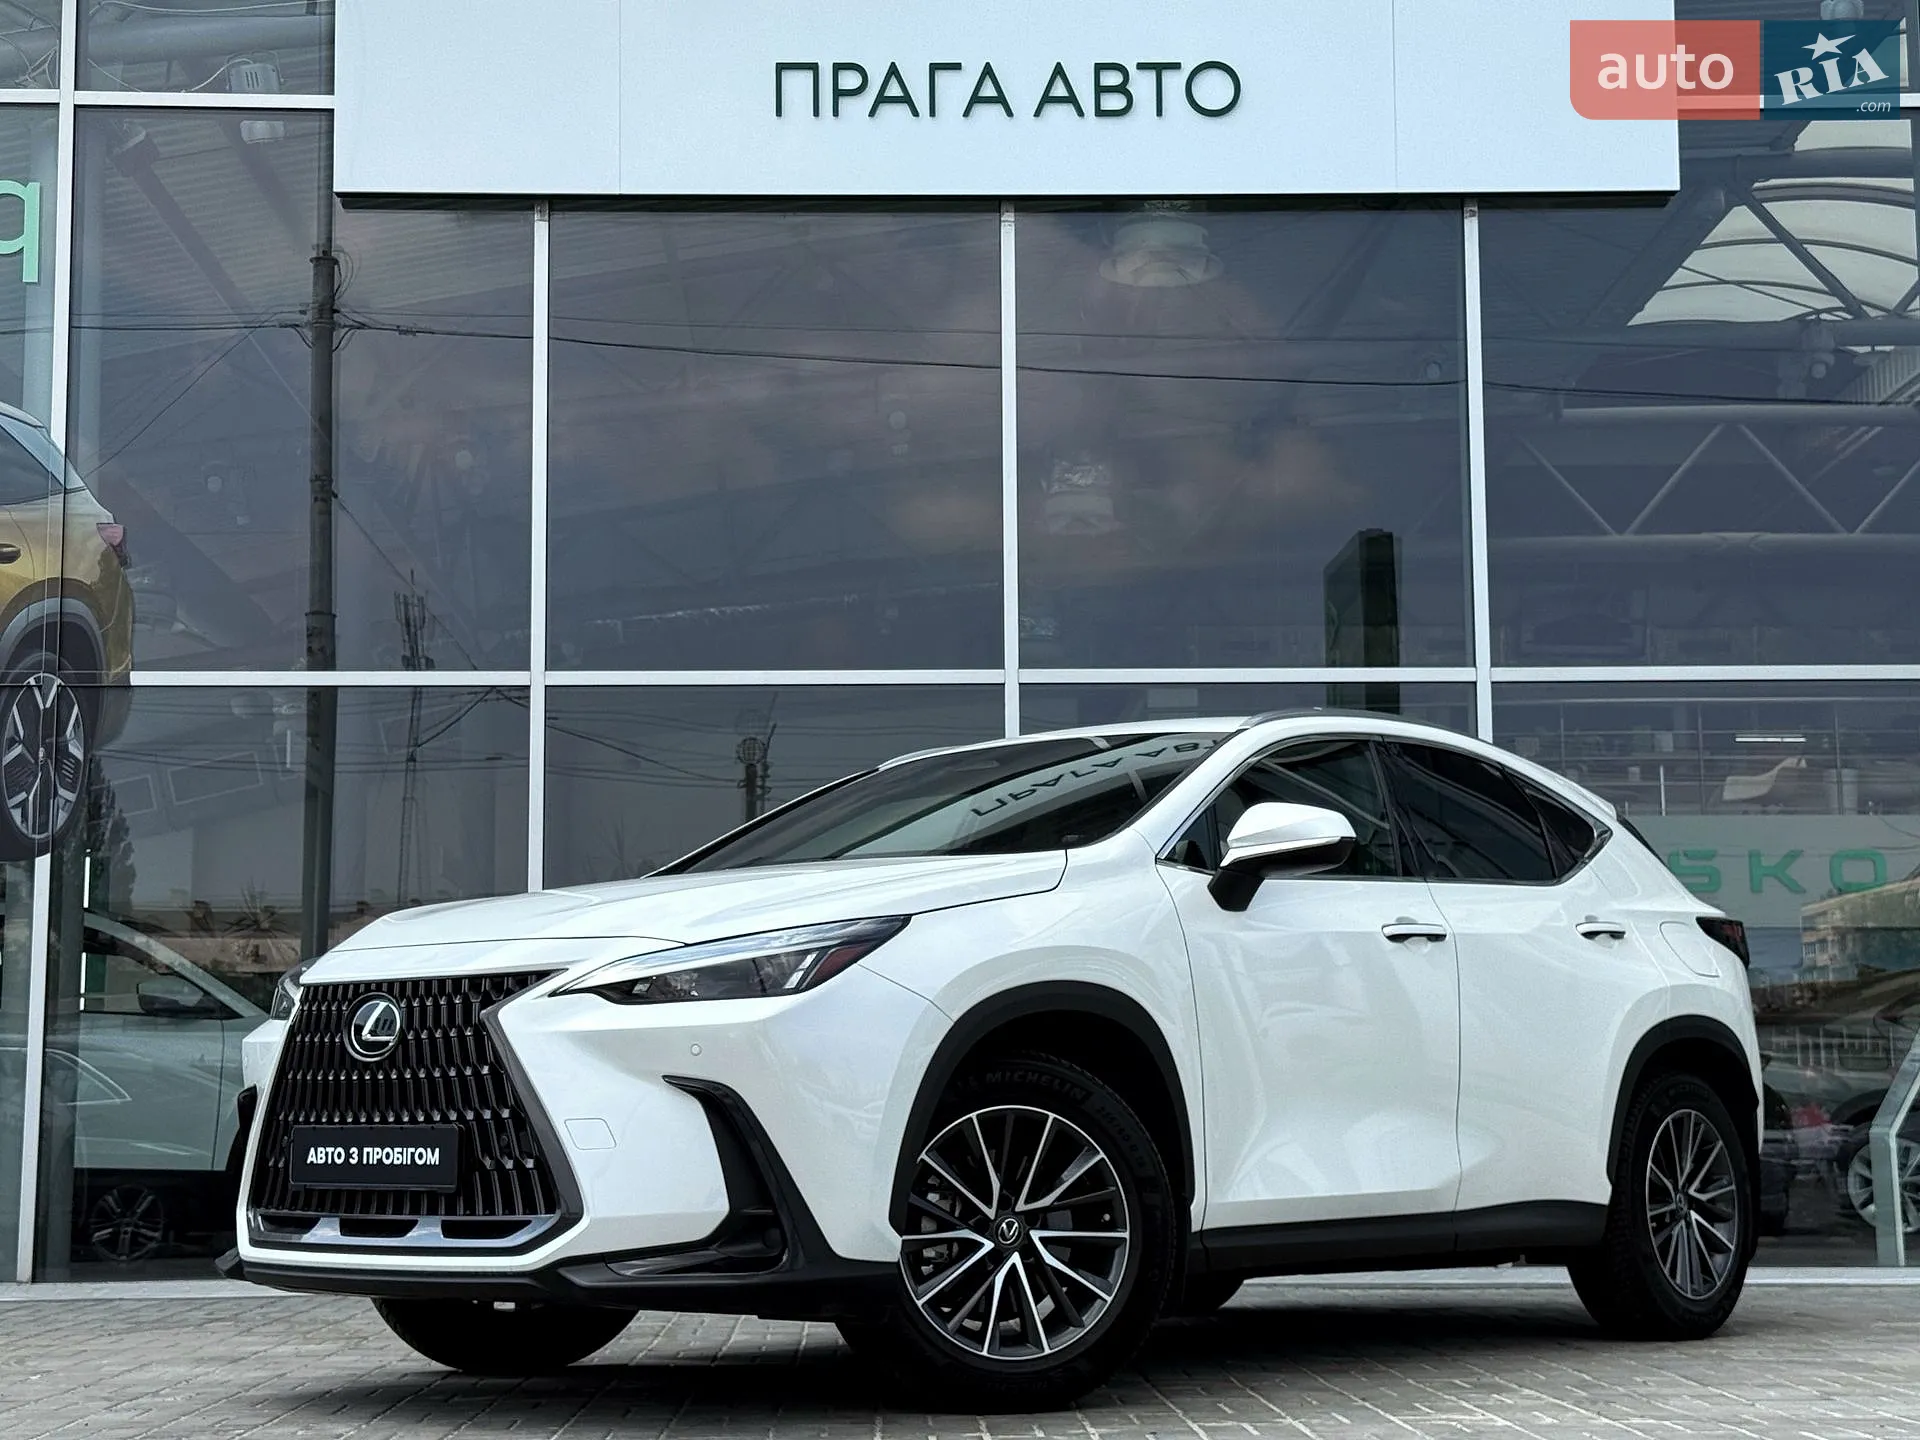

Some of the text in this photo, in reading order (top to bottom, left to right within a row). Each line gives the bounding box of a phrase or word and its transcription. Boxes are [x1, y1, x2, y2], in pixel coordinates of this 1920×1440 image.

[775, 60, 1241, 118] ПРАГА АВТО
[985, 1070, 1087, 1101] MICHELIN
[306, 1146, 345, 1165] АВТО
[362, 1147, 440, 1166] ПРОБІГОМ
